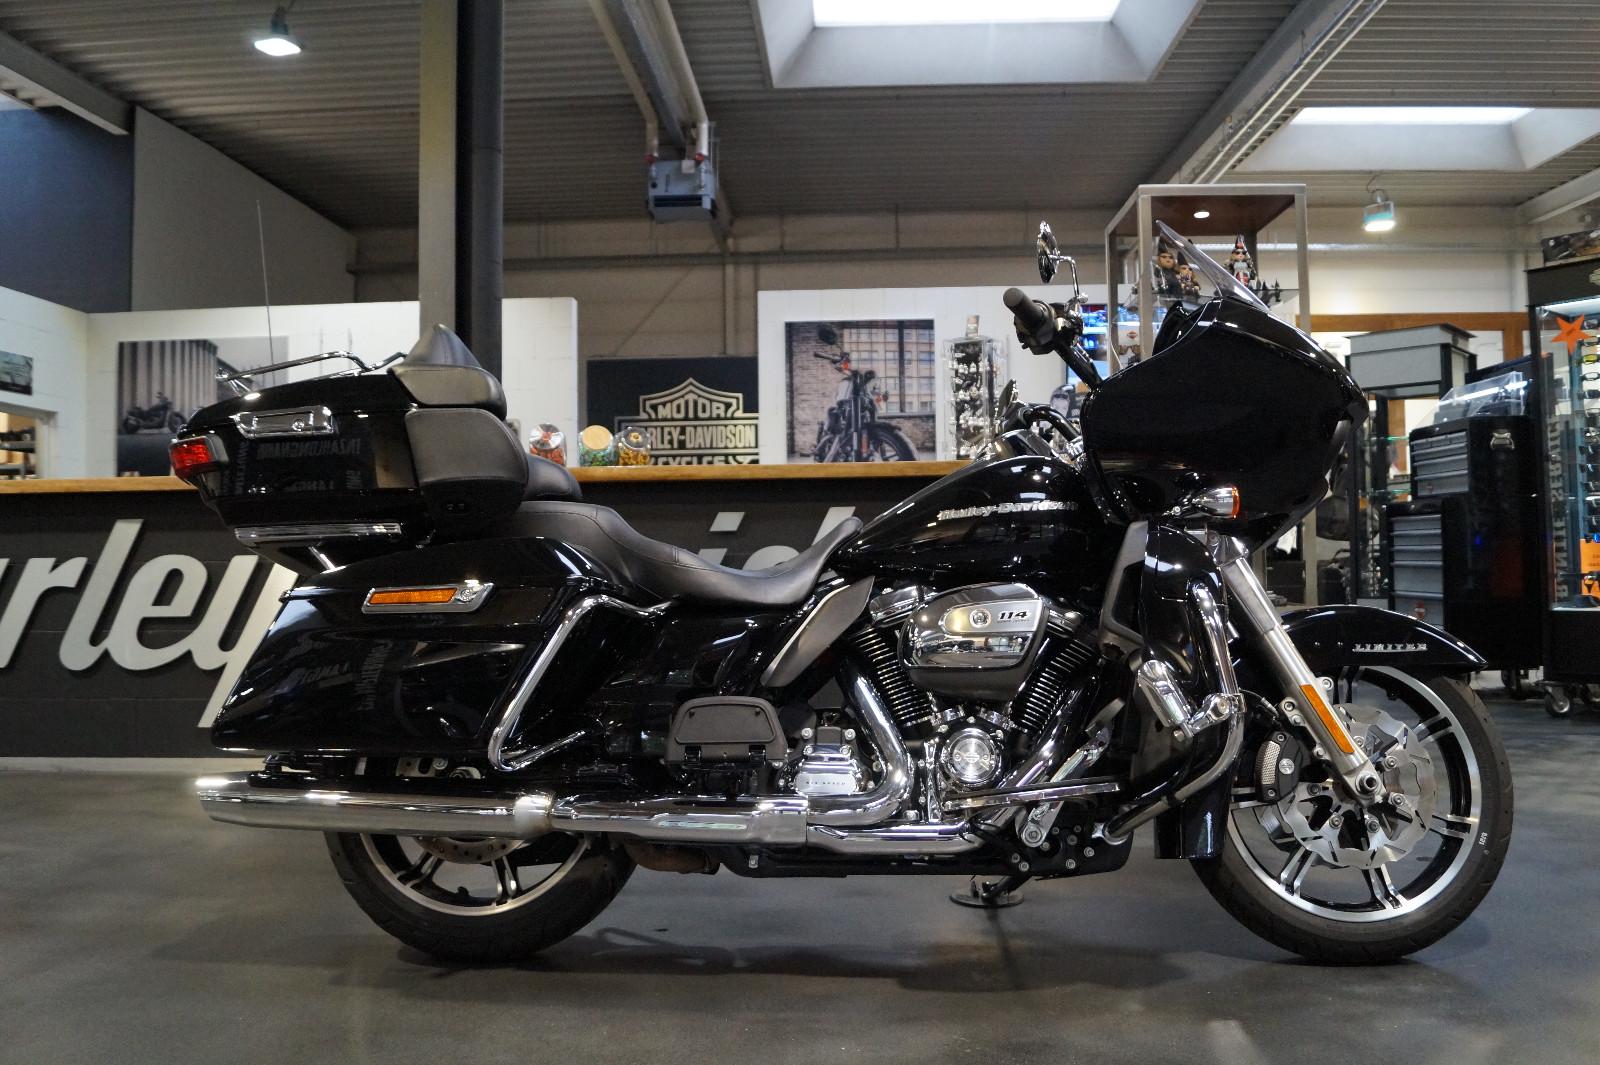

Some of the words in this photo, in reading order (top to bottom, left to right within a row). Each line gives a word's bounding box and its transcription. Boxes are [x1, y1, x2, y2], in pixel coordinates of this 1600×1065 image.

[659, 393, 726, 419] MOTOR
[645, 426, 756, 449] RLEY-DAVIDSON
[0, 519, 298, 727] rley
[1000, 611, 1028, 620] 114
